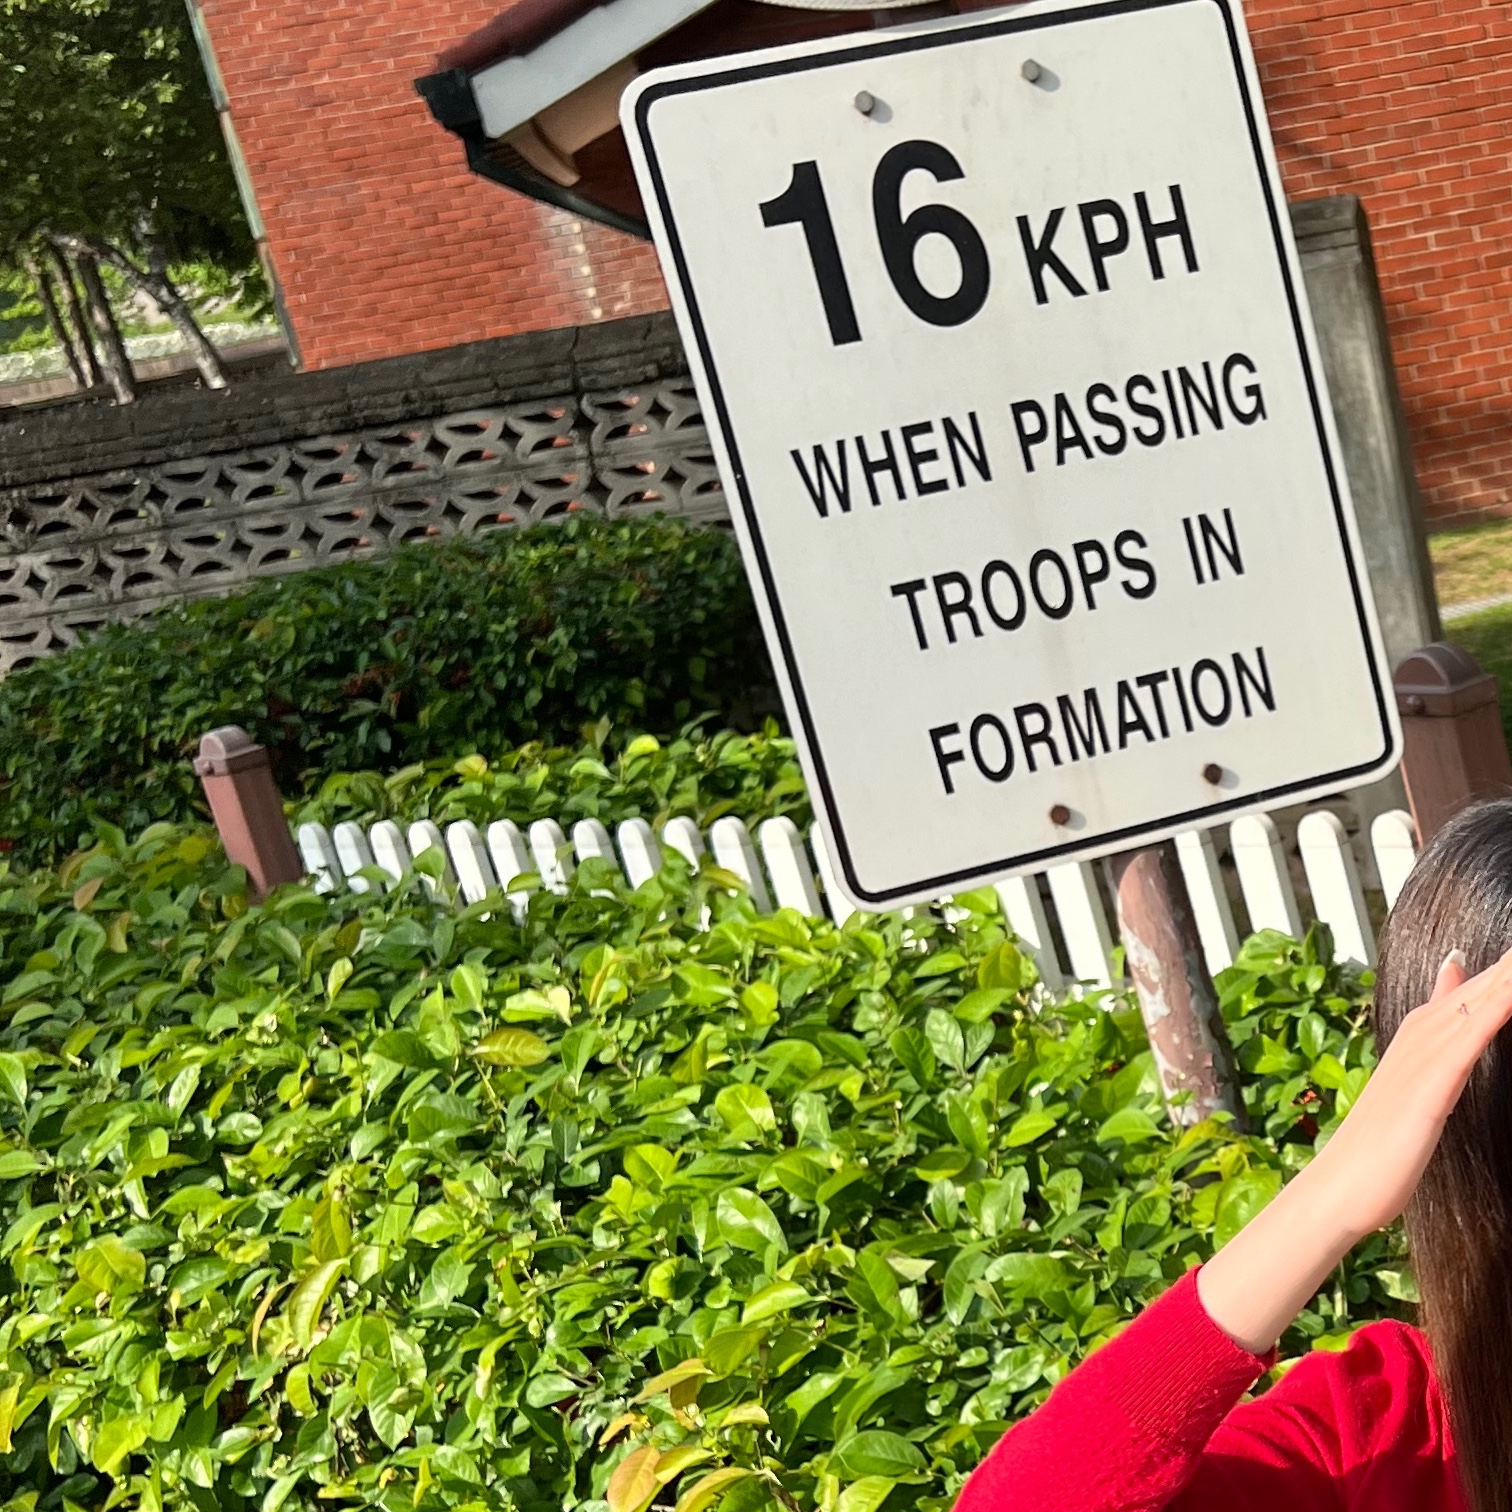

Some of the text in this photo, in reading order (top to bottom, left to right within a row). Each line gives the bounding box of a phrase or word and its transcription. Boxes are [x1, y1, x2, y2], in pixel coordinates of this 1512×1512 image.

[760, 140, 1198, 345] 16 KPH
[791, 353, 1267, 517] WHEN PASSING
[891, 509, 1243, 649] TROOPS IN
[929, 647, 1276, 794] FORMATION
